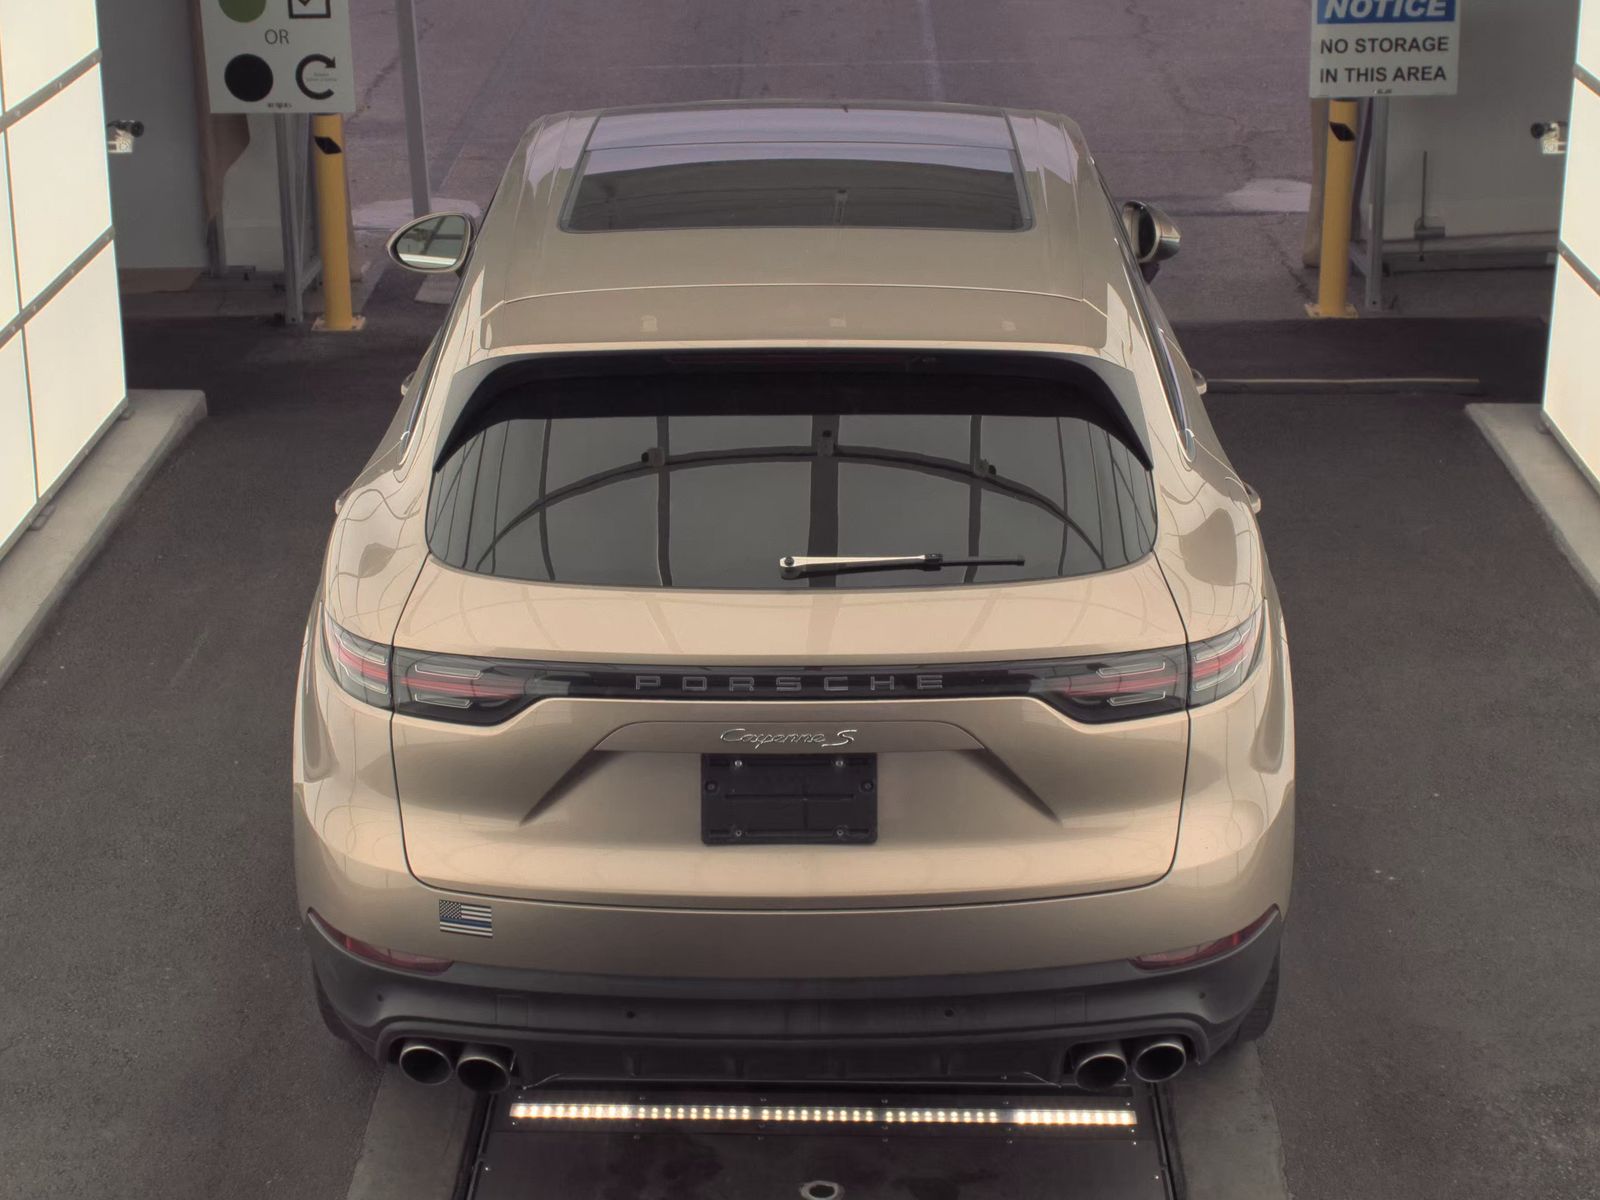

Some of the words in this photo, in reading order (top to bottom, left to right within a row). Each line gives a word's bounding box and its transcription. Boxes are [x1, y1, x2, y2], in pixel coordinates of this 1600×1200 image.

[1324, 0, 1446, 18] NOTICE
[264, 29, 290, 44] OR
[1320, 38, 1348, 54] NO
[1355, 36, 1449, 53] STORAGE
[1320, 68, 1338, 83] IN
[1345, 67, 1387, 82] THIS
[1393, 66, 1447, 81] AREA
[635, 674, 943, 692] PORSCHE
[720, 728, 825, 749] Cayenne
[822, 729, 857, 747] S
